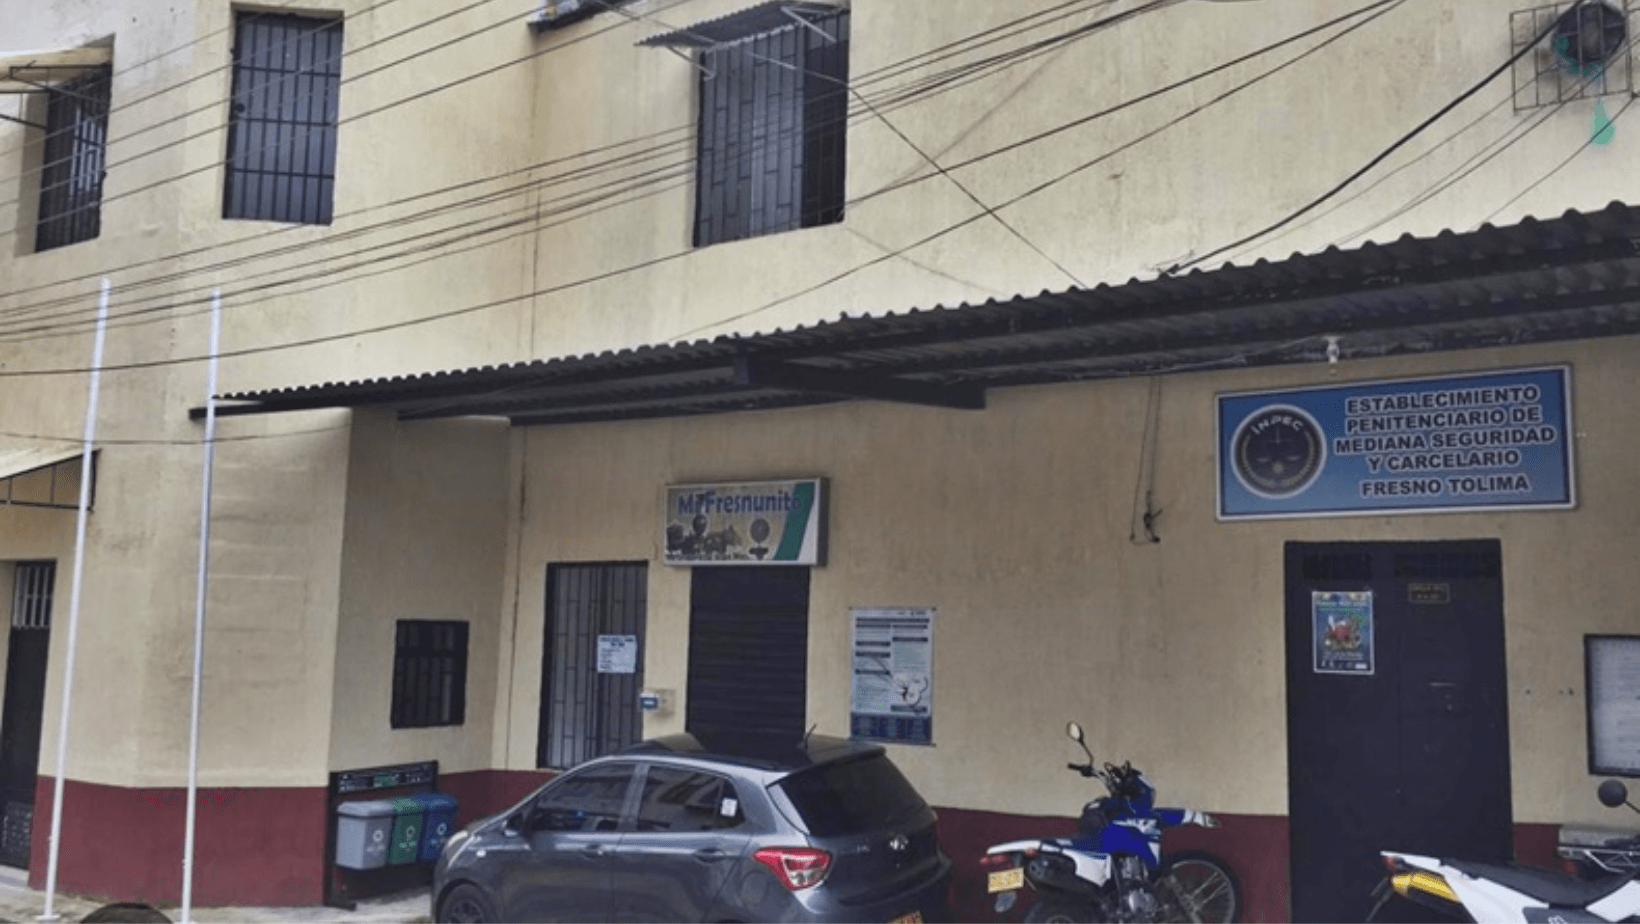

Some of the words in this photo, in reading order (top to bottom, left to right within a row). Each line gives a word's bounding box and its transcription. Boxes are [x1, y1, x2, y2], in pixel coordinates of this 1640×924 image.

[1347, 386, 1538, 414] ESTABLECIMIENTO
[1250, 415, 1304, 435] INPEC
[1346, 411, 1505, 433] PENITENCIARIO
[1512, 406, 1540, 424] DE
[1336, 436, 1425, 454] MEDIANA
[1432, 428, 1555, 448] SEGURIDAD
[1369, 457, 1381, 472] Y
[1388, 450, 1520, 471] CARCELARIO
[1362, 480, 1441, 497] FRESNO
[1450, 476, 1529, 494] TOLIMA
